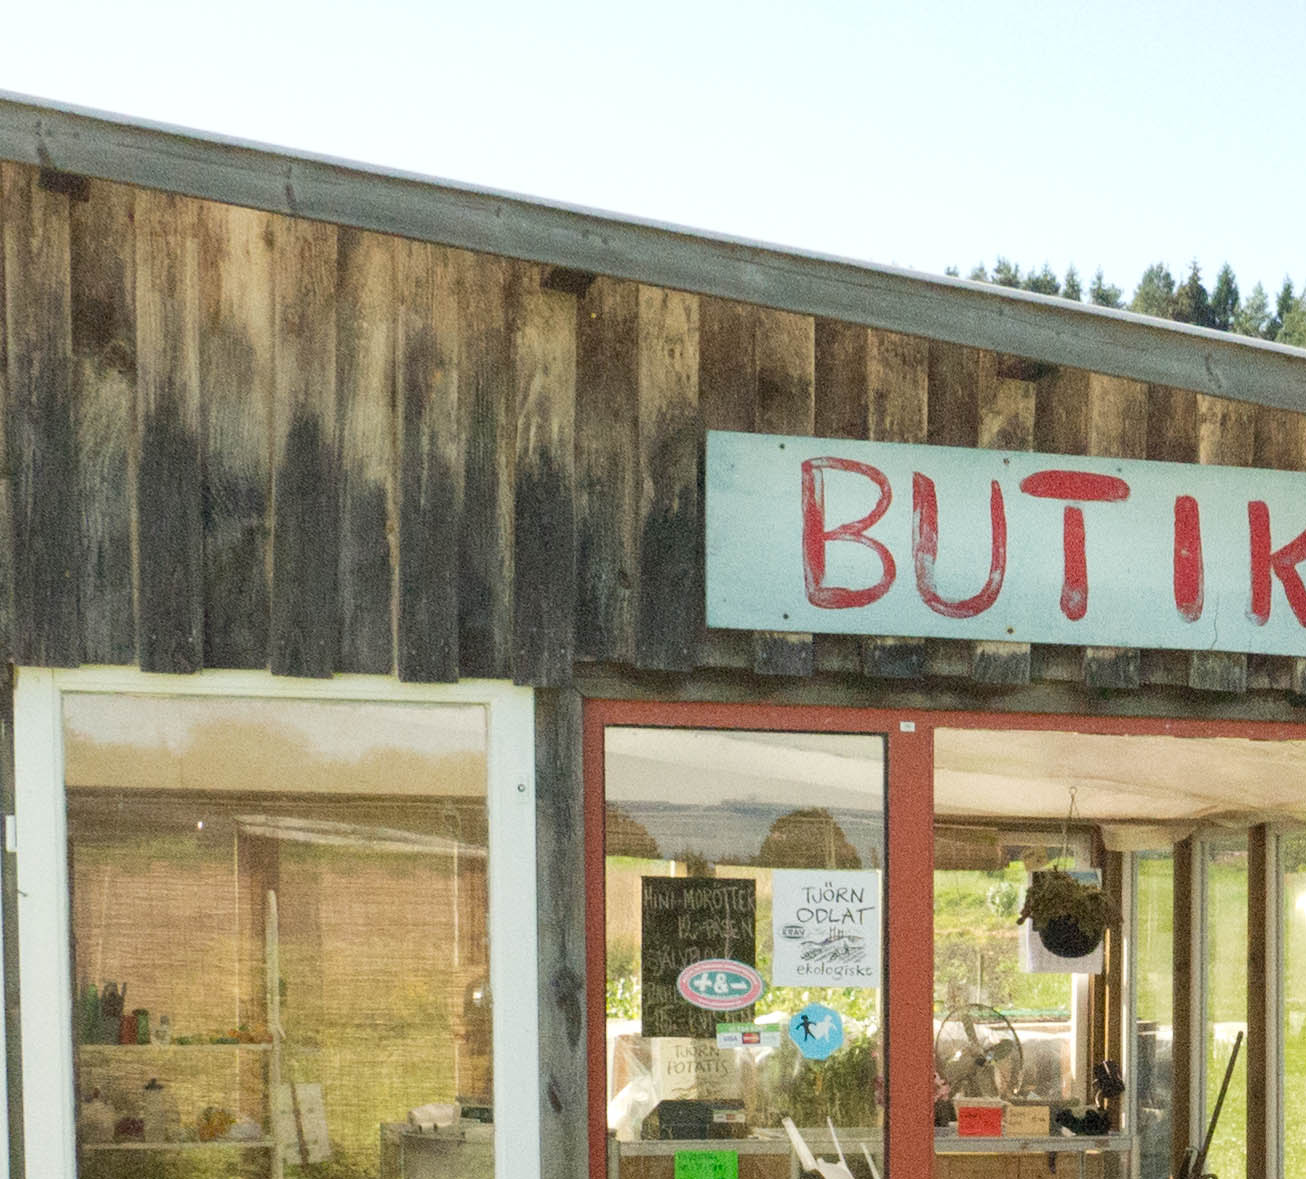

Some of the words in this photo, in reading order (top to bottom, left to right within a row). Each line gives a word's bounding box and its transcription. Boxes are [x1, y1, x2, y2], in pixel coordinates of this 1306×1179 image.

[801, 881, 864, 904] TJÖRN
[796, 906, 876, 925] ODLAT
[796, 962, 873, 980] ekologiskt
